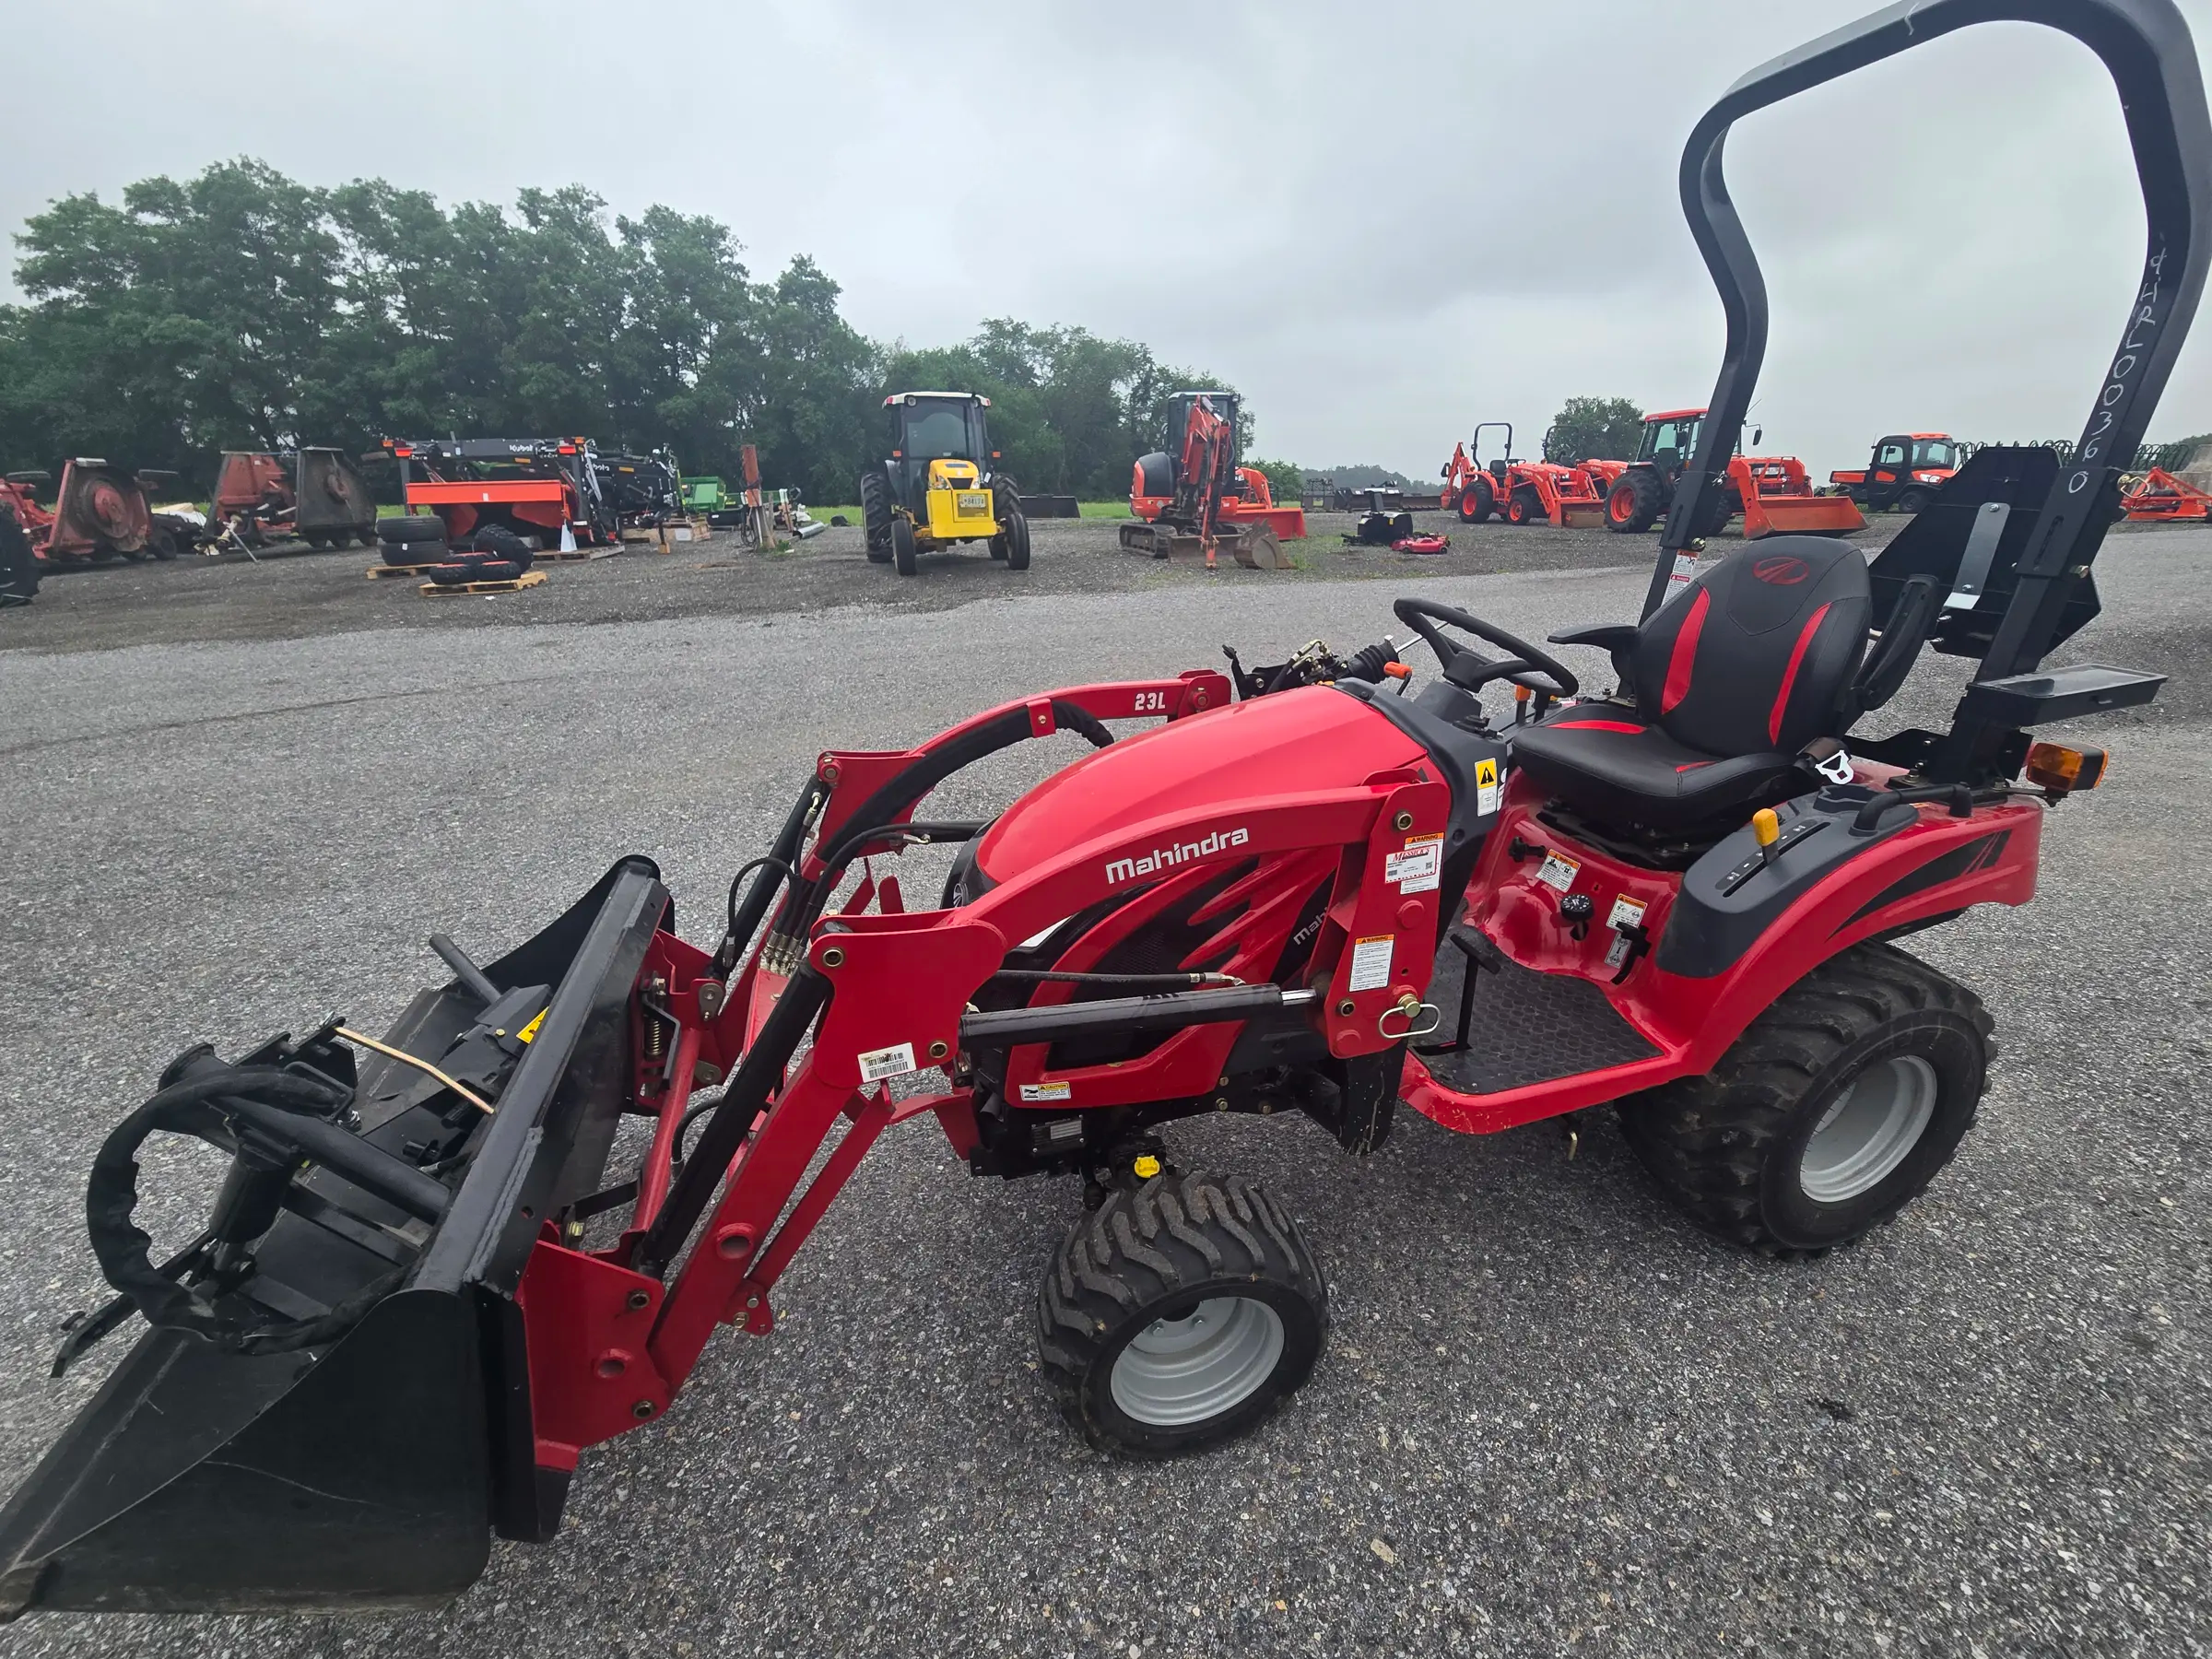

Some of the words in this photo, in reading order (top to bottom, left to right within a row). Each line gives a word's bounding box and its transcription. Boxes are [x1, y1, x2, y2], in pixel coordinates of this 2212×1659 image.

[509, 444, 534, 453] Kubot
[1135, 691, 1166, 711] 23L
[1416, 833, 1439, 841] WARNING
[1106, 828, 1249, 884] Mahindra
